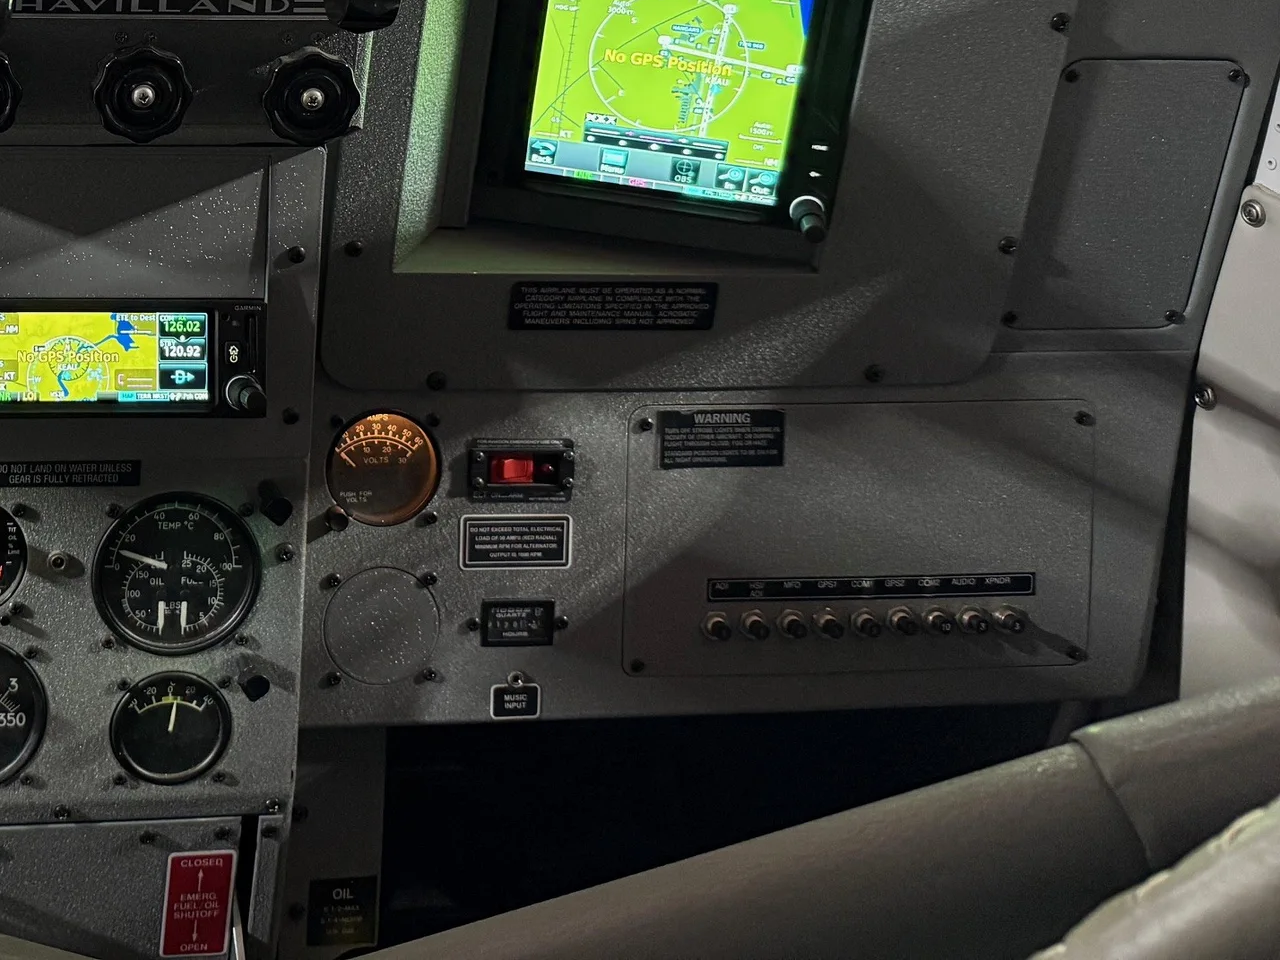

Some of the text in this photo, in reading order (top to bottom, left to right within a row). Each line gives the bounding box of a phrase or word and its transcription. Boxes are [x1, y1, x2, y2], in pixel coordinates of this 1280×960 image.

[604, 49, 733, 77] No GPS Position
[164, 321, 200, 332] 126.02
[18, 351, 119, 362] No GPS Position
[164, 346, 200, 357] 120.92
[694, 413, 750, 424] WARNING
[11, 464, 27, 474] NOT
[29, 464, 52, 474] LAND
[55, 464, 68, 473] ON
[69, 464, 97, 473] WATER
[99, 463, 132, 473] UNLESS
[9, 474, 119, 484] GEAR IS FULLY RETRACTED
[181, 858, 222, 867] CLOSED
[333, 888, 353, 900] OIL
[180, 943, 207, 951] OPEN
